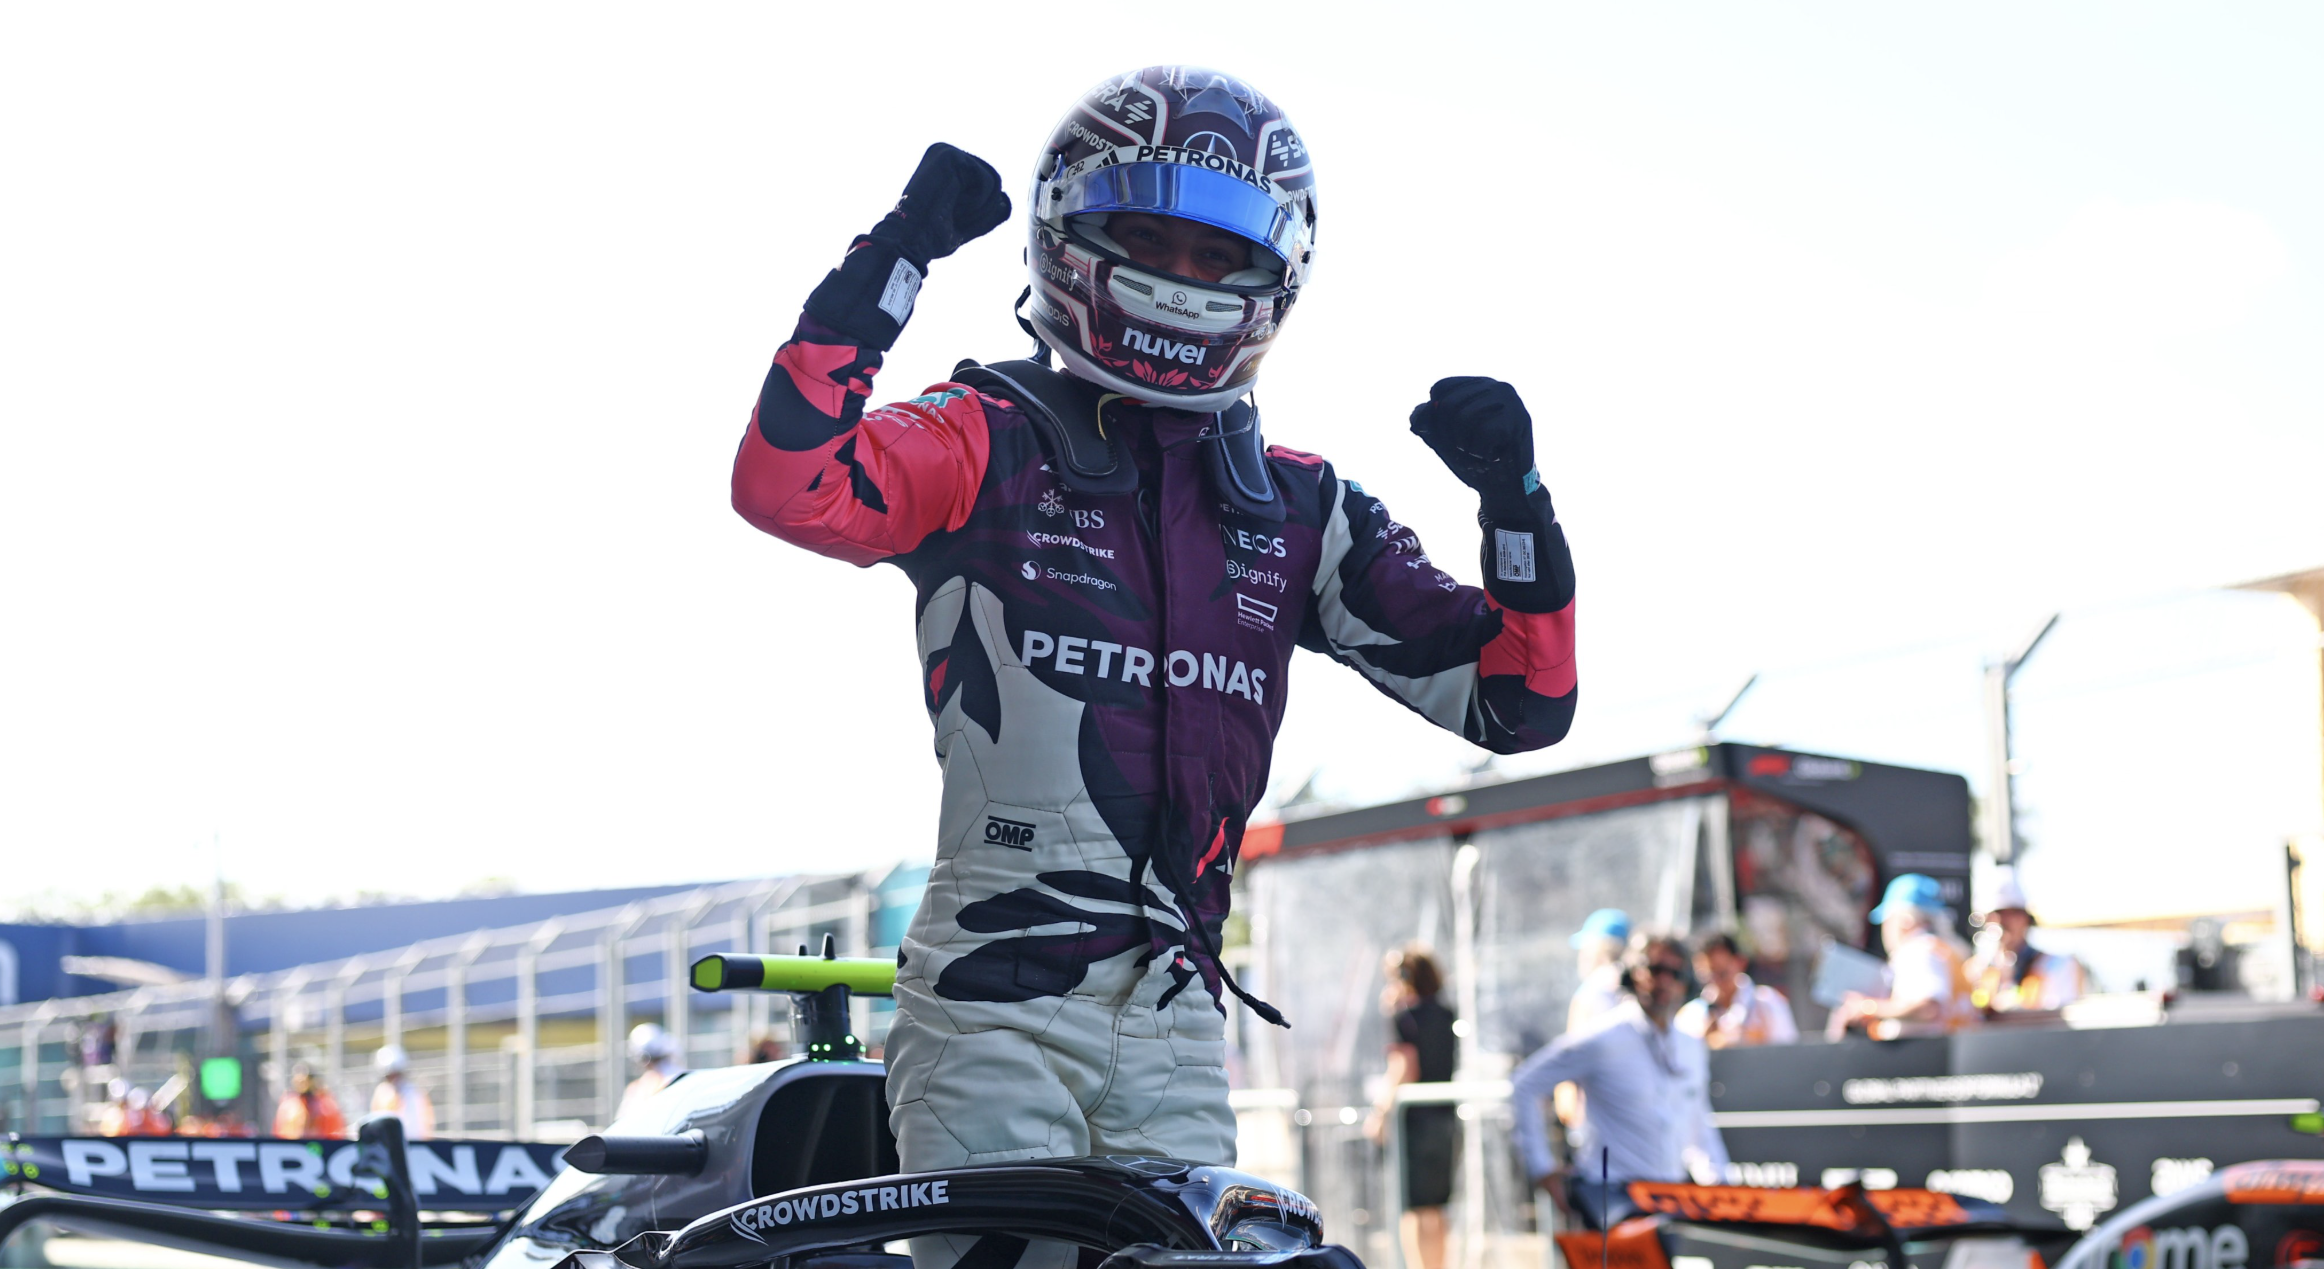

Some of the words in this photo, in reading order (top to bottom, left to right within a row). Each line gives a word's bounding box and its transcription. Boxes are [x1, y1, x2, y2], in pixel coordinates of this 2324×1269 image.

[1066, 119, 1117, 152] CROWDST
[1136, 145, 1272, 195] PETRONAS
[1155, 300, 1200, 320] WhatsApp
[1122, 325, 1210, 366] nuvei
[1069, 509, 1105, 529] BS
[1033, 531, 1115, 560] CROWDSTRIKE
[1219, 523, 1287, 558] NEOS
[1046, 567, 1117, 592] Snapdragon
[1237, 618, 1265, 633] Enterprise
[1021, 629, 1267, 706] PETRONAS
[984, 820, 1035, 846] OMP
[61, 1139, 568, 1194] PETRONA
[740, 1179, 950, 1231] CROWDSTRIKE
